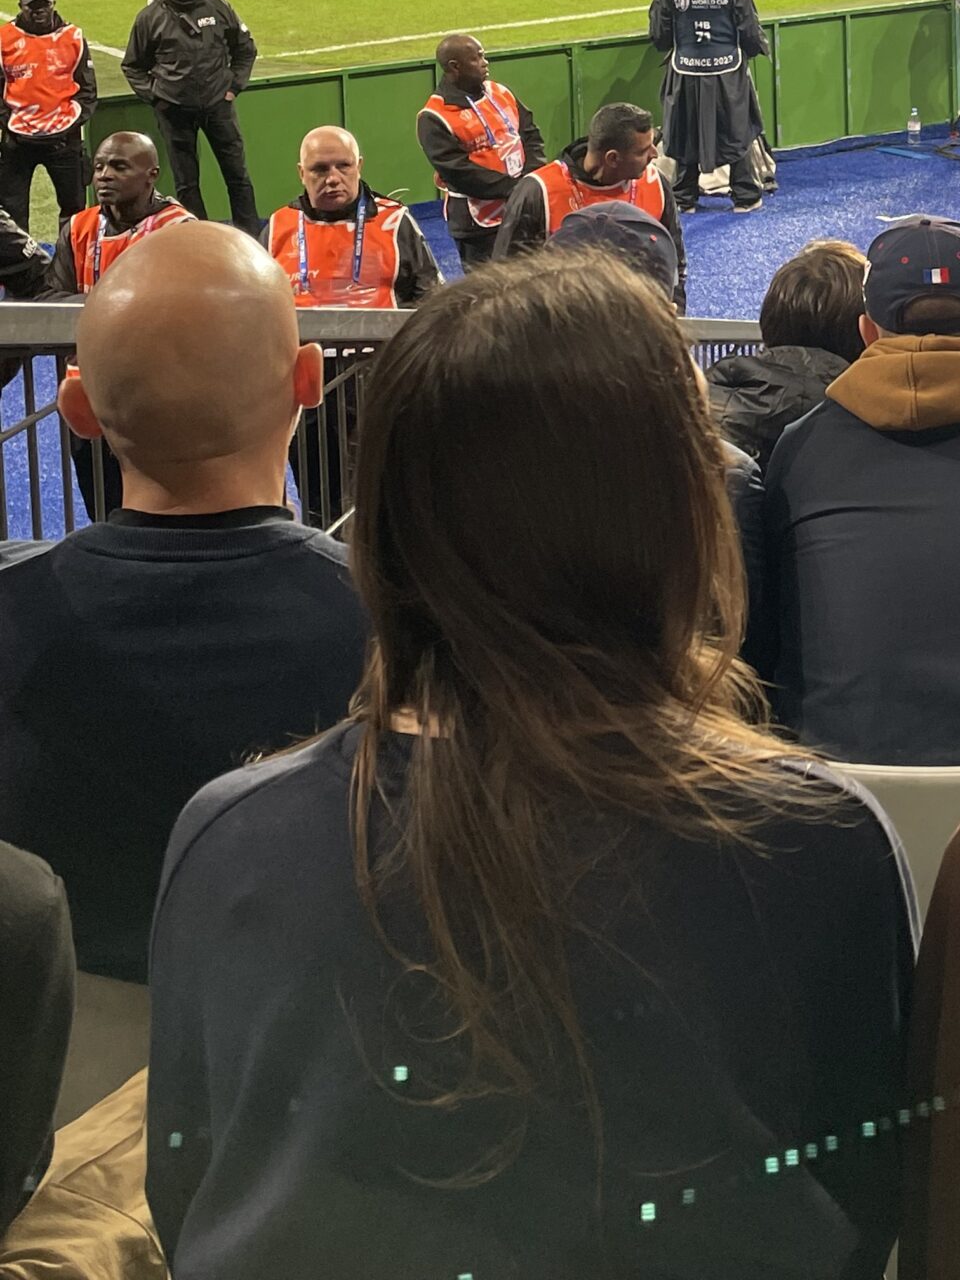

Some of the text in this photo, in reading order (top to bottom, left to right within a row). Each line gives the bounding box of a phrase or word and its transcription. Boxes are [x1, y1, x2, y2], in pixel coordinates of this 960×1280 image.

[694, 21, 711, 30] HB
[680, 55, 733, 67] FRANCE 2023
